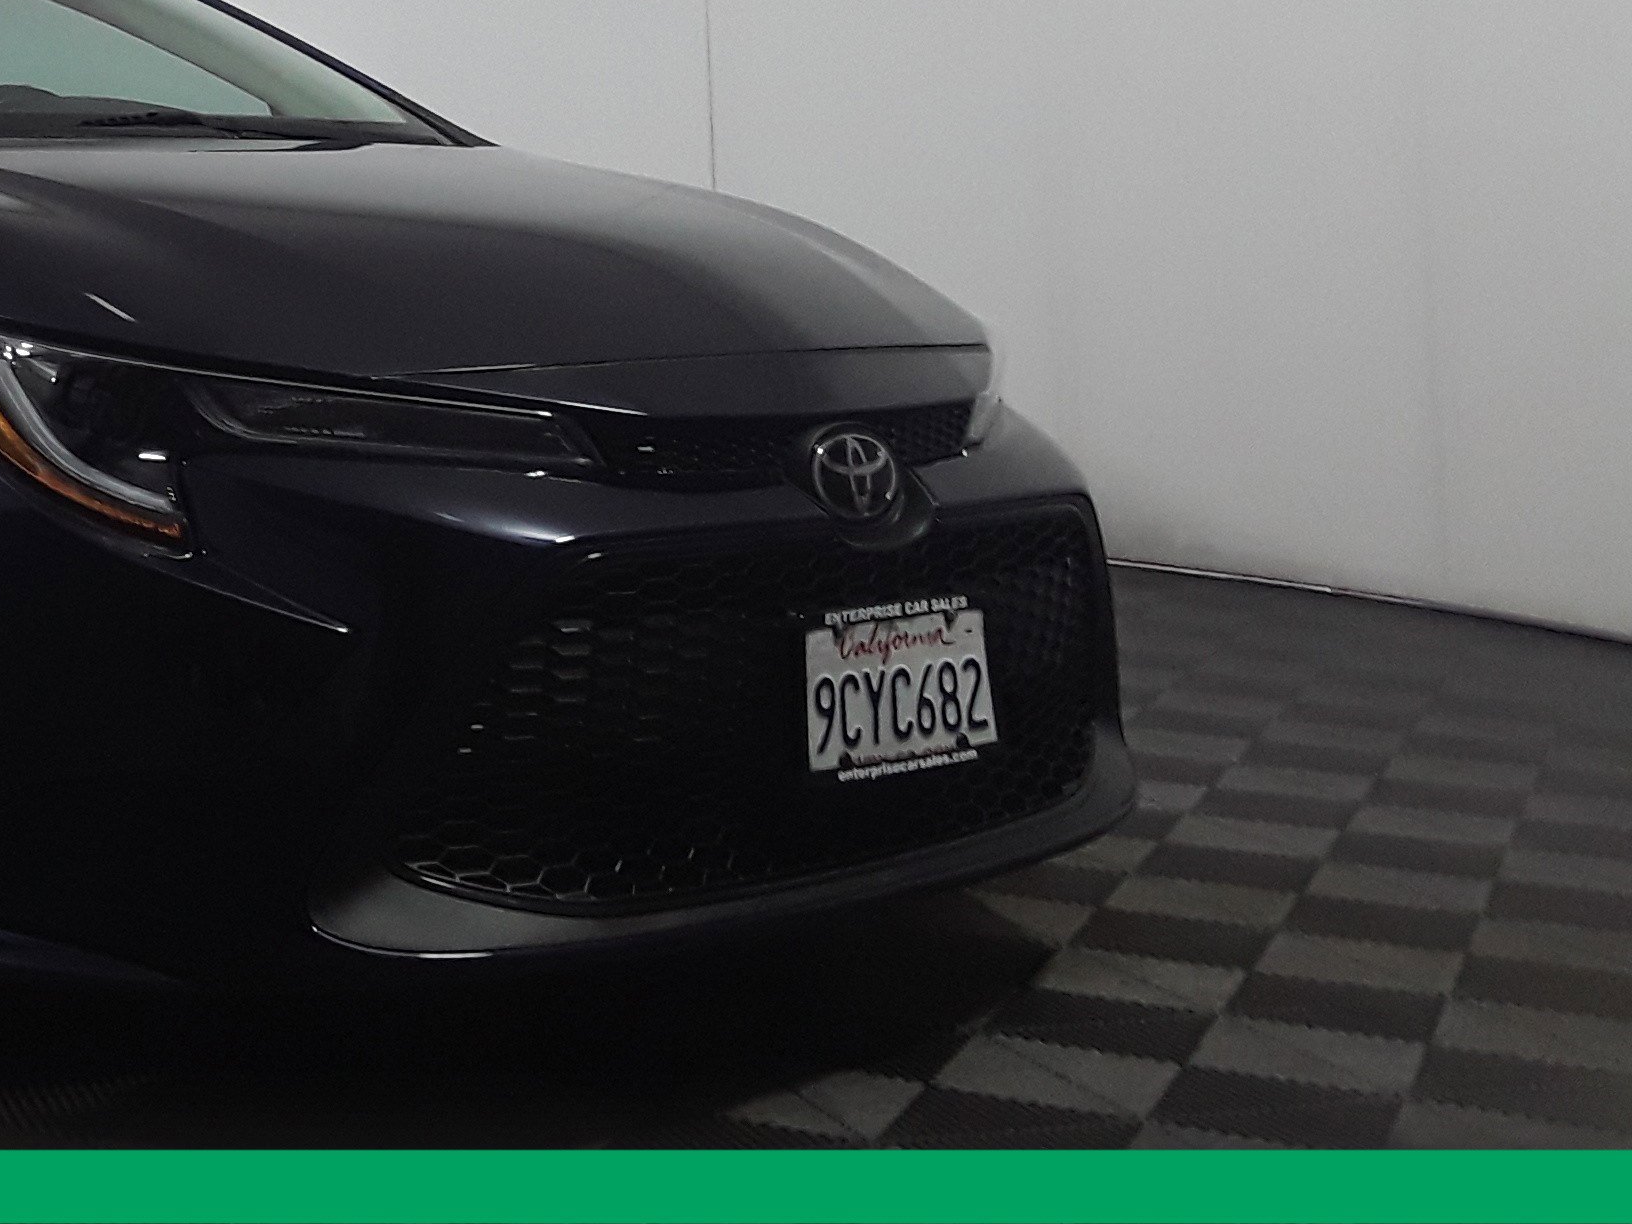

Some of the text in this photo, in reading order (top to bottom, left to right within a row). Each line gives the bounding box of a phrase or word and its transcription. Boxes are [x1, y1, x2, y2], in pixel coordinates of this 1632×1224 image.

[824, 596, 968, 625] ENTERPRISE CAR SALES
[837, 623, 956, 665] California
[813, 657, 989, 756] 9CYC682
[837, 749, 978, 782] enterprisecarsales.com
